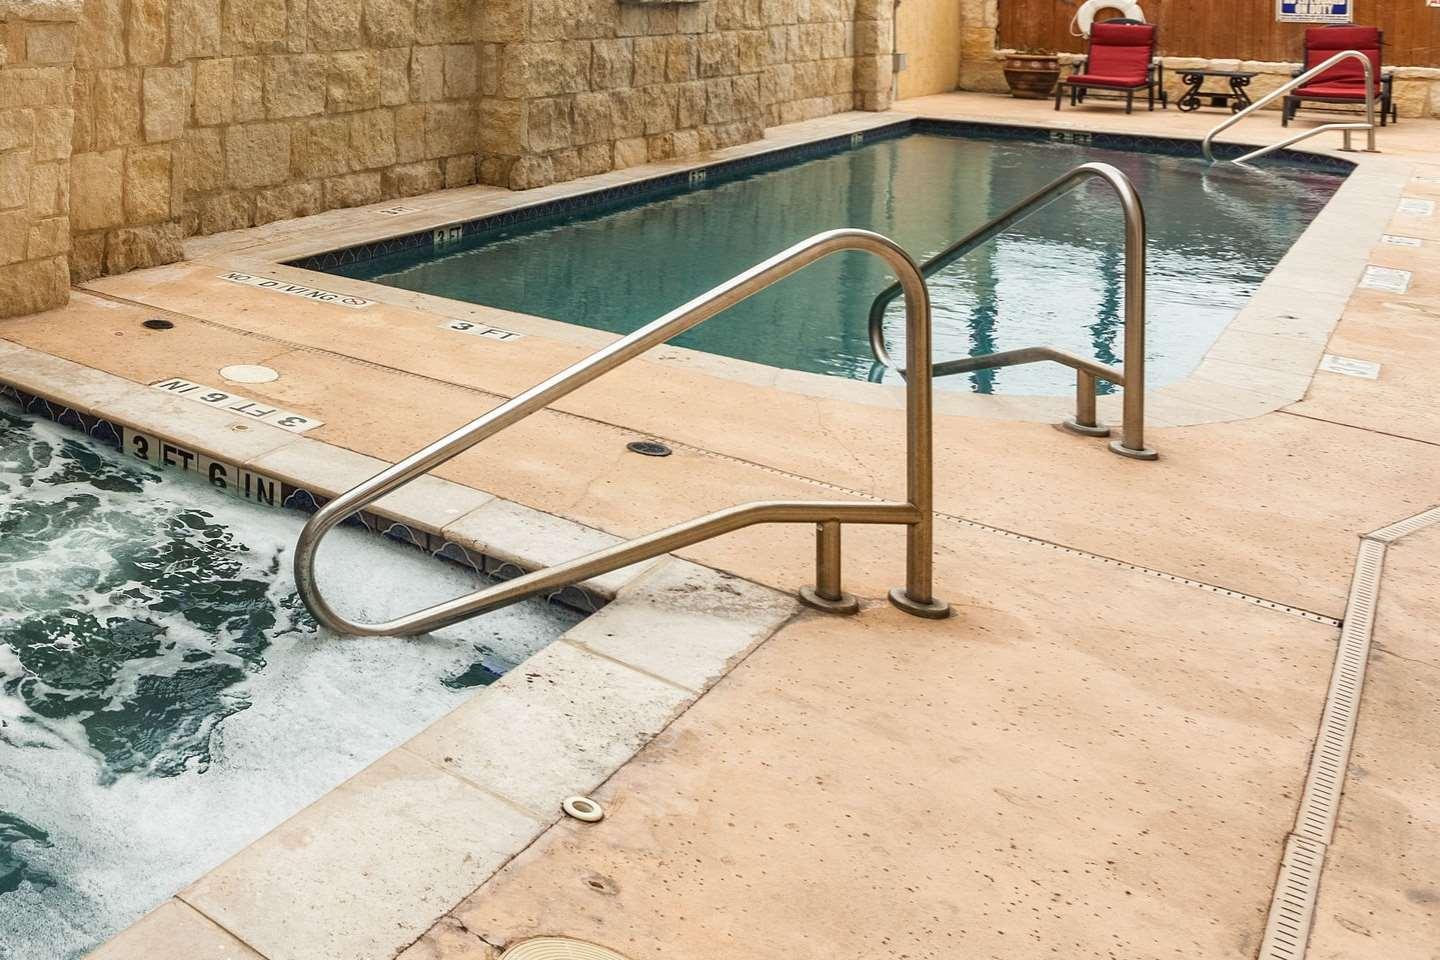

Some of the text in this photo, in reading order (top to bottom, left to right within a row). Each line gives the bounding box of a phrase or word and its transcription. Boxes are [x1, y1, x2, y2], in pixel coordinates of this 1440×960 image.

[1295, 4, 1333, 14] ON DUTY
[449, 226, 463, 241] FT
[223, 271, 338, 302] NO DIVING
[451, 322, 521, 340] 3 FT
[159, 380, 308, 428] 3 FT 6 IN
[132, 434, 276, 507] 3 FT 6 IN
